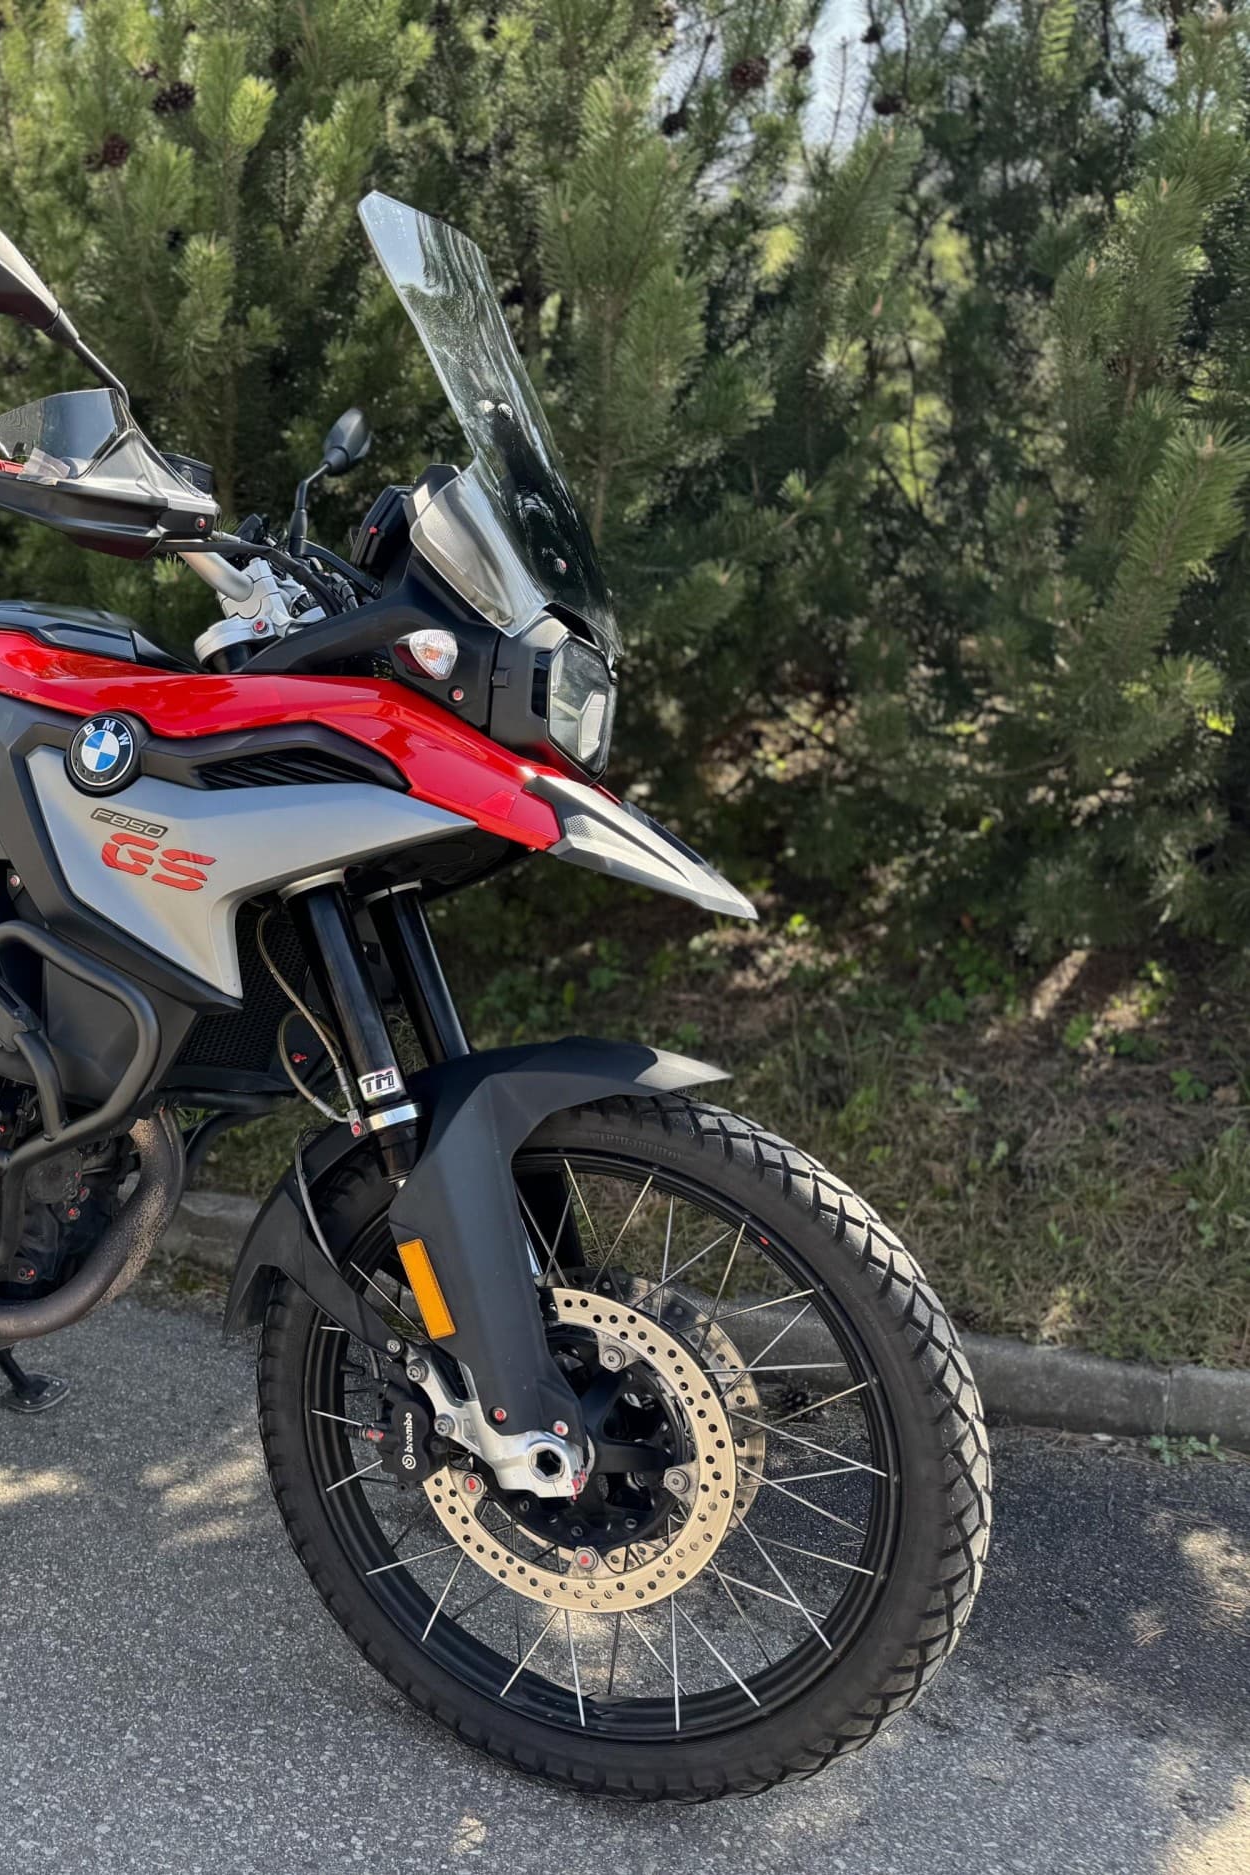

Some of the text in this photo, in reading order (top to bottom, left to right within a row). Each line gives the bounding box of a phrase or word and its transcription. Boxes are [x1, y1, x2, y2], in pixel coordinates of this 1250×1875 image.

[83, 719, 131, 746] BMW
[92, 809, 166, 838] F850
[101, 832, 216, 892] GS
[403, 1412, 414, 1454] brembo
